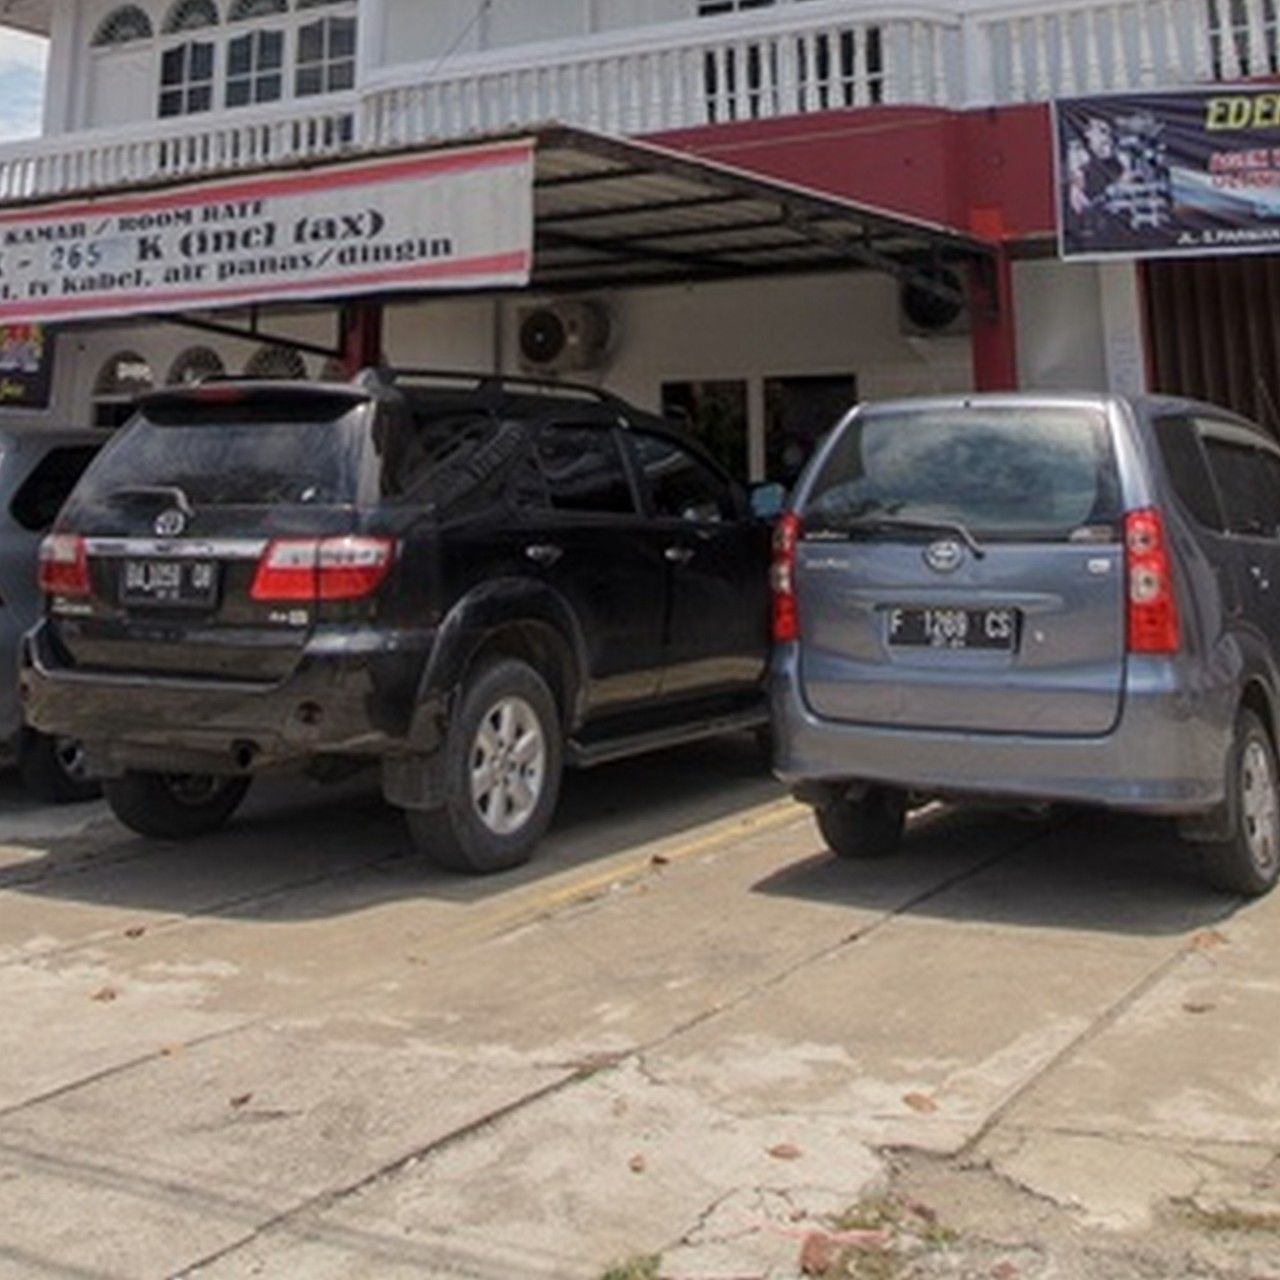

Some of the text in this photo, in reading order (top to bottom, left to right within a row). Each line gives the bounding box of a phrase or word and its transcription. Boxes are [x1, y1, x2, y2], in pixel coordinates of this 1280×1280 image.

[4, 222, 87, 246] KAMAR
[118, 207, 193, 233] ROOM
[201, 200, 264, 222] RATE
[137, 234, 164, 262] K
[890, 609, 903, 634] F
[984, 610, 1011, 639] CS
